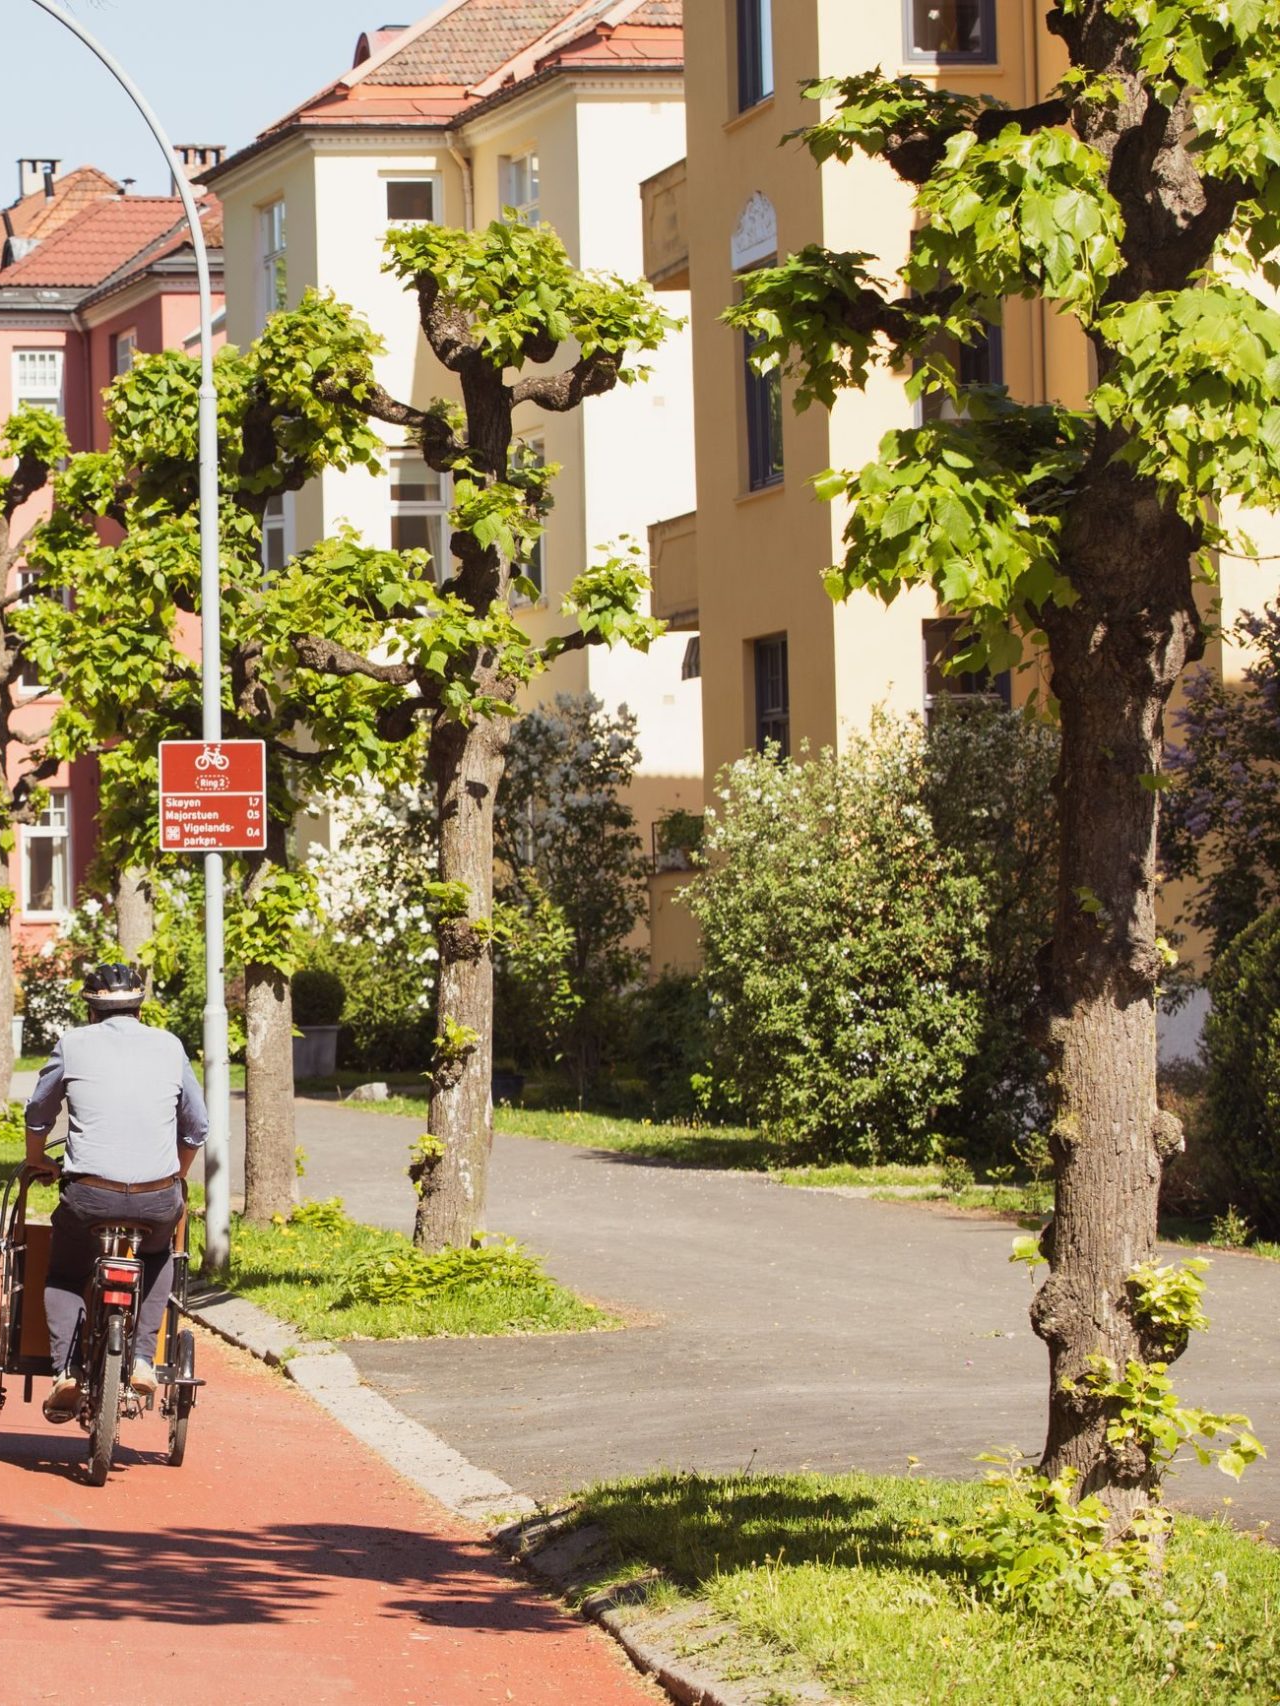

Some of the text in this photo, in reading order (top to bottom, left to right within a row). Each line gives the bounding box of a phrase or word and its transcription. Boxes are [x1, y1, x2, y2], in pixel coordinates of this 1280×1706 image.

[200, 779, 225, 788] Ring 2
[166, 797, 260, 809] Skøyen 1,7
[165, 810, 219, 822] Majorstuen
[183, 823, 260, 838] Vigelands- 0,4
[183, 837, 217, 847] parken
